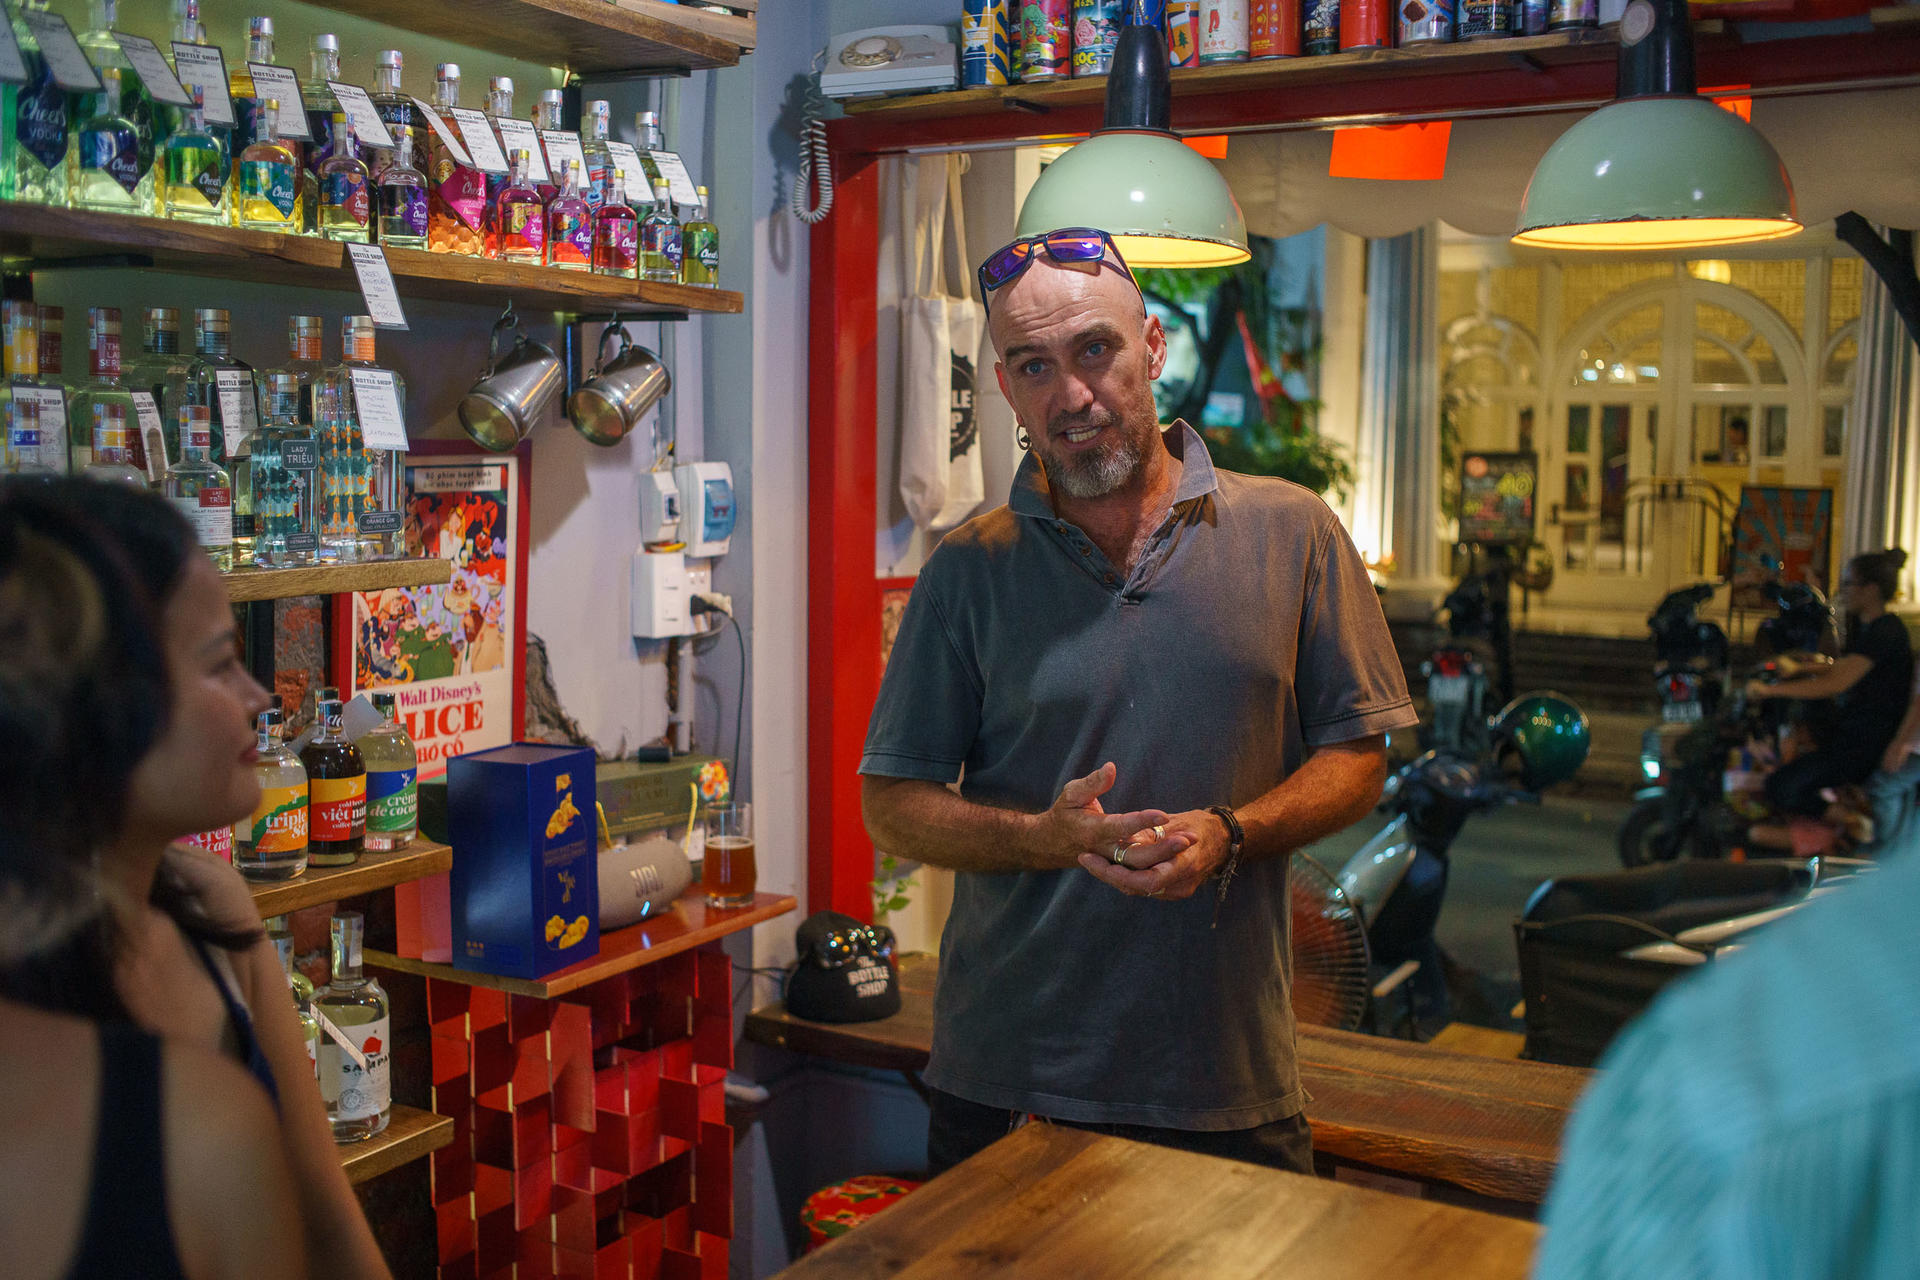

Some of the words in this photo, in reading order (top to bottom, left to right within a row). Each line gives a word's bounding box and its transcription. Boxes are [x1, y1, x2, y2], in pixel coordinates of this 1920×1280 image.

[253, 71, 276, 79] BOTTLE
[353, 251, 370, 259] BOTTLE
[219, 379, 238, 387] BOTTLE
[355, 377, 376, 385] BOTTLE
[400, 688, 427, 708] Walt
[430, 681, 482, 702] Disney's
[266, 808, 306, 830] triple
[630, 864, 660, 897] JBL
